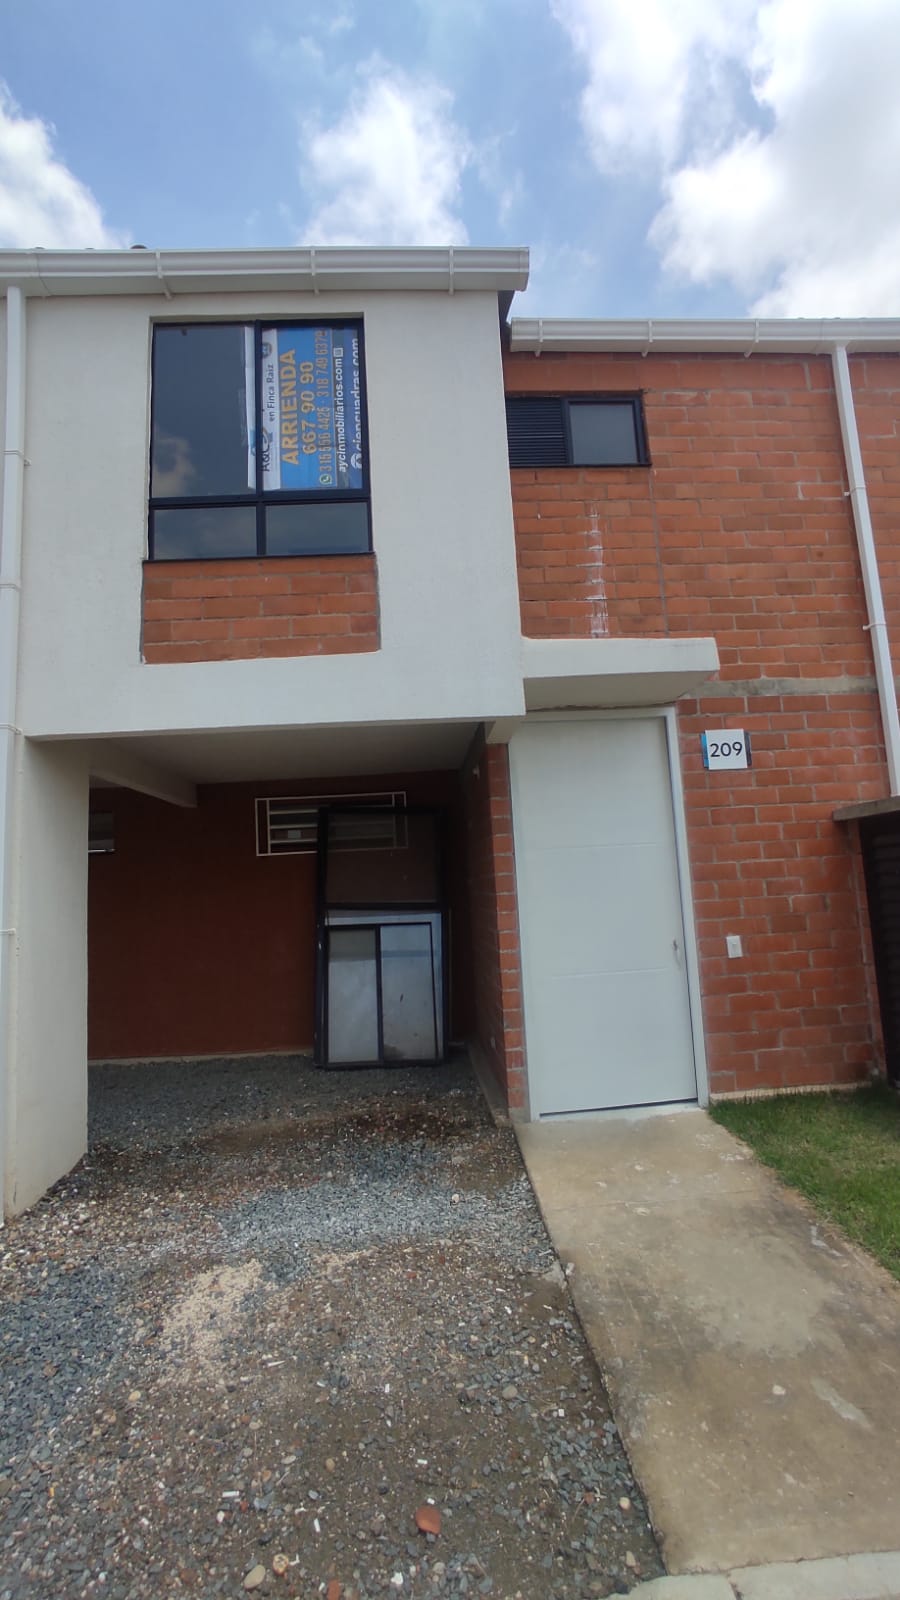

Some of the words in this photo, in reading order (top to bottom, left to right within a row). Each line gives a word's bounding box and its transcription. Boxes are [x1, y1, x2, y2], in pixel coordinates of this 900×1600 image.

[300, 361, 314, 384] 90
[266, 387, 275, 409] Finca
[280, 349, 299, 465] ARRIENDA
[301, 391, 315, 413] 90
[350, 338, 361, 451] ciencuadrascom
[335, 358, 348, 472] aycinmobiliarios.com
[302, 420, 317, 454] 667
[710, 741, 743, 758] 209
